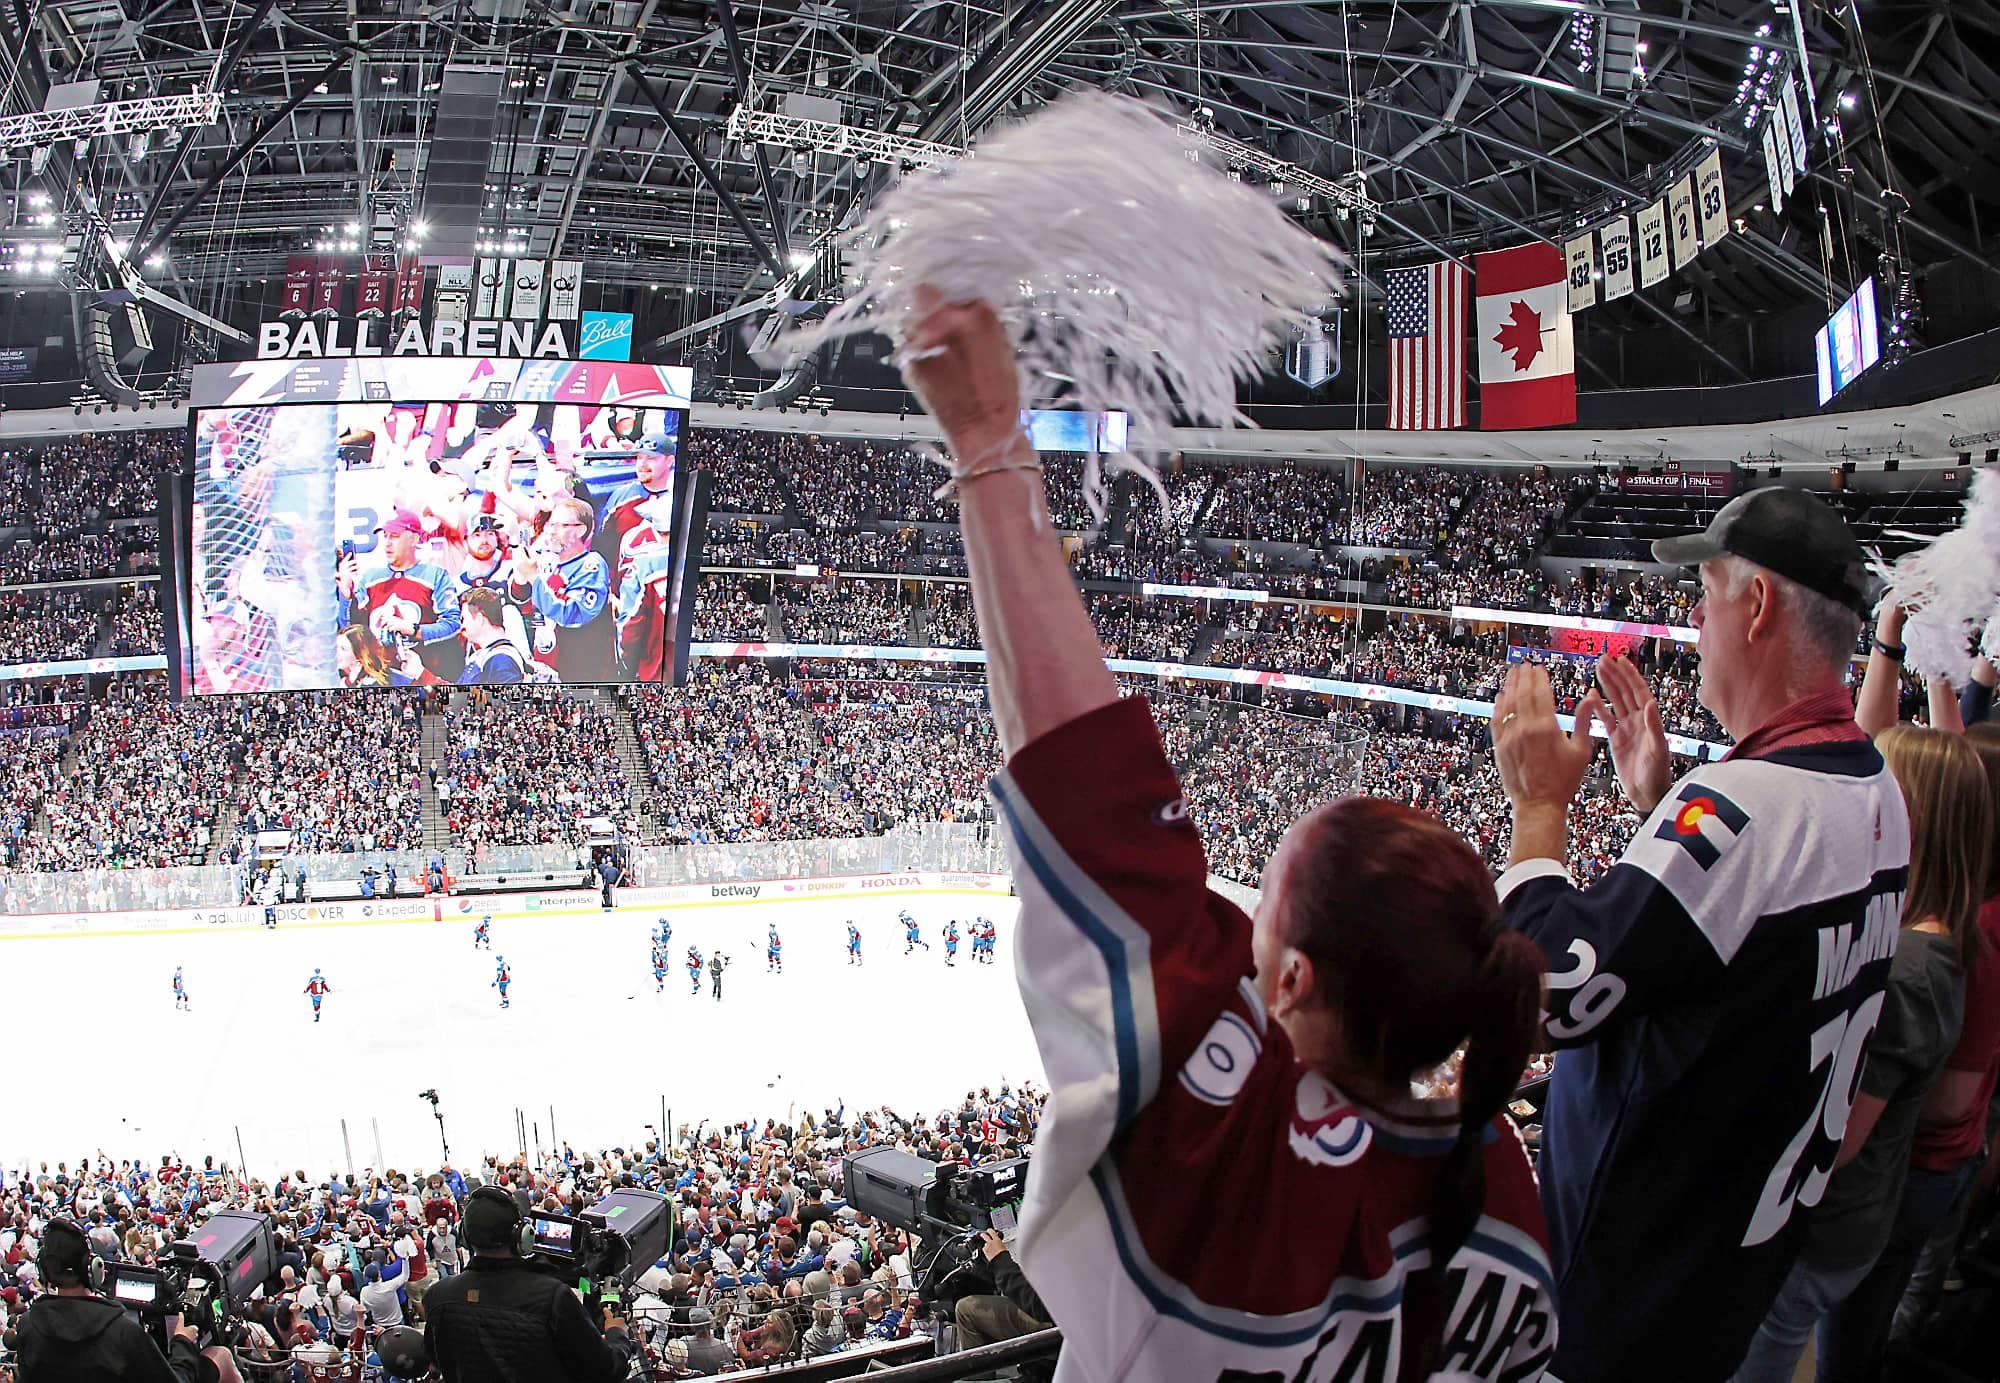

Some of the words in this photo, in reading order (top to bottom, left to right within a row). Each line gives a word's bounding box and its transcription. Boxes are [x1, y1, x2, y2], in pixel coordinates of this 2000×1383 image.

[1704, 186, 1721, 220] 33
[1678, 213, 1688, 240] 2
[1645, 233, 1662, 261] 12
[1606, 248, 1629, 275] 55
[1570, 262, 1590, 289] 432
[292, 289, 300, 302] 6
[324, 288, 331, 302] 9
[365, 288, 380, 302] 22
[581, 316, 632, 347] Ball
[1325, 323, 1336, 332] 22
[258, 321, 382, 359] BALL
[393, 320, 570, 359] ARENA
[1633, 476, 1664, 485] STANLEY
[1664, 477, 1679, 485] CUP
[1689, 477, 1711, 486] FINAL
[861, 876, 922, 888] HONDA
[711, 885, 760, 897] betway
[277, 906, 343, 920] DISCOVER
[377, 903, 426, 916] Expedia
[1541, 937, 1627, 1039] 29
